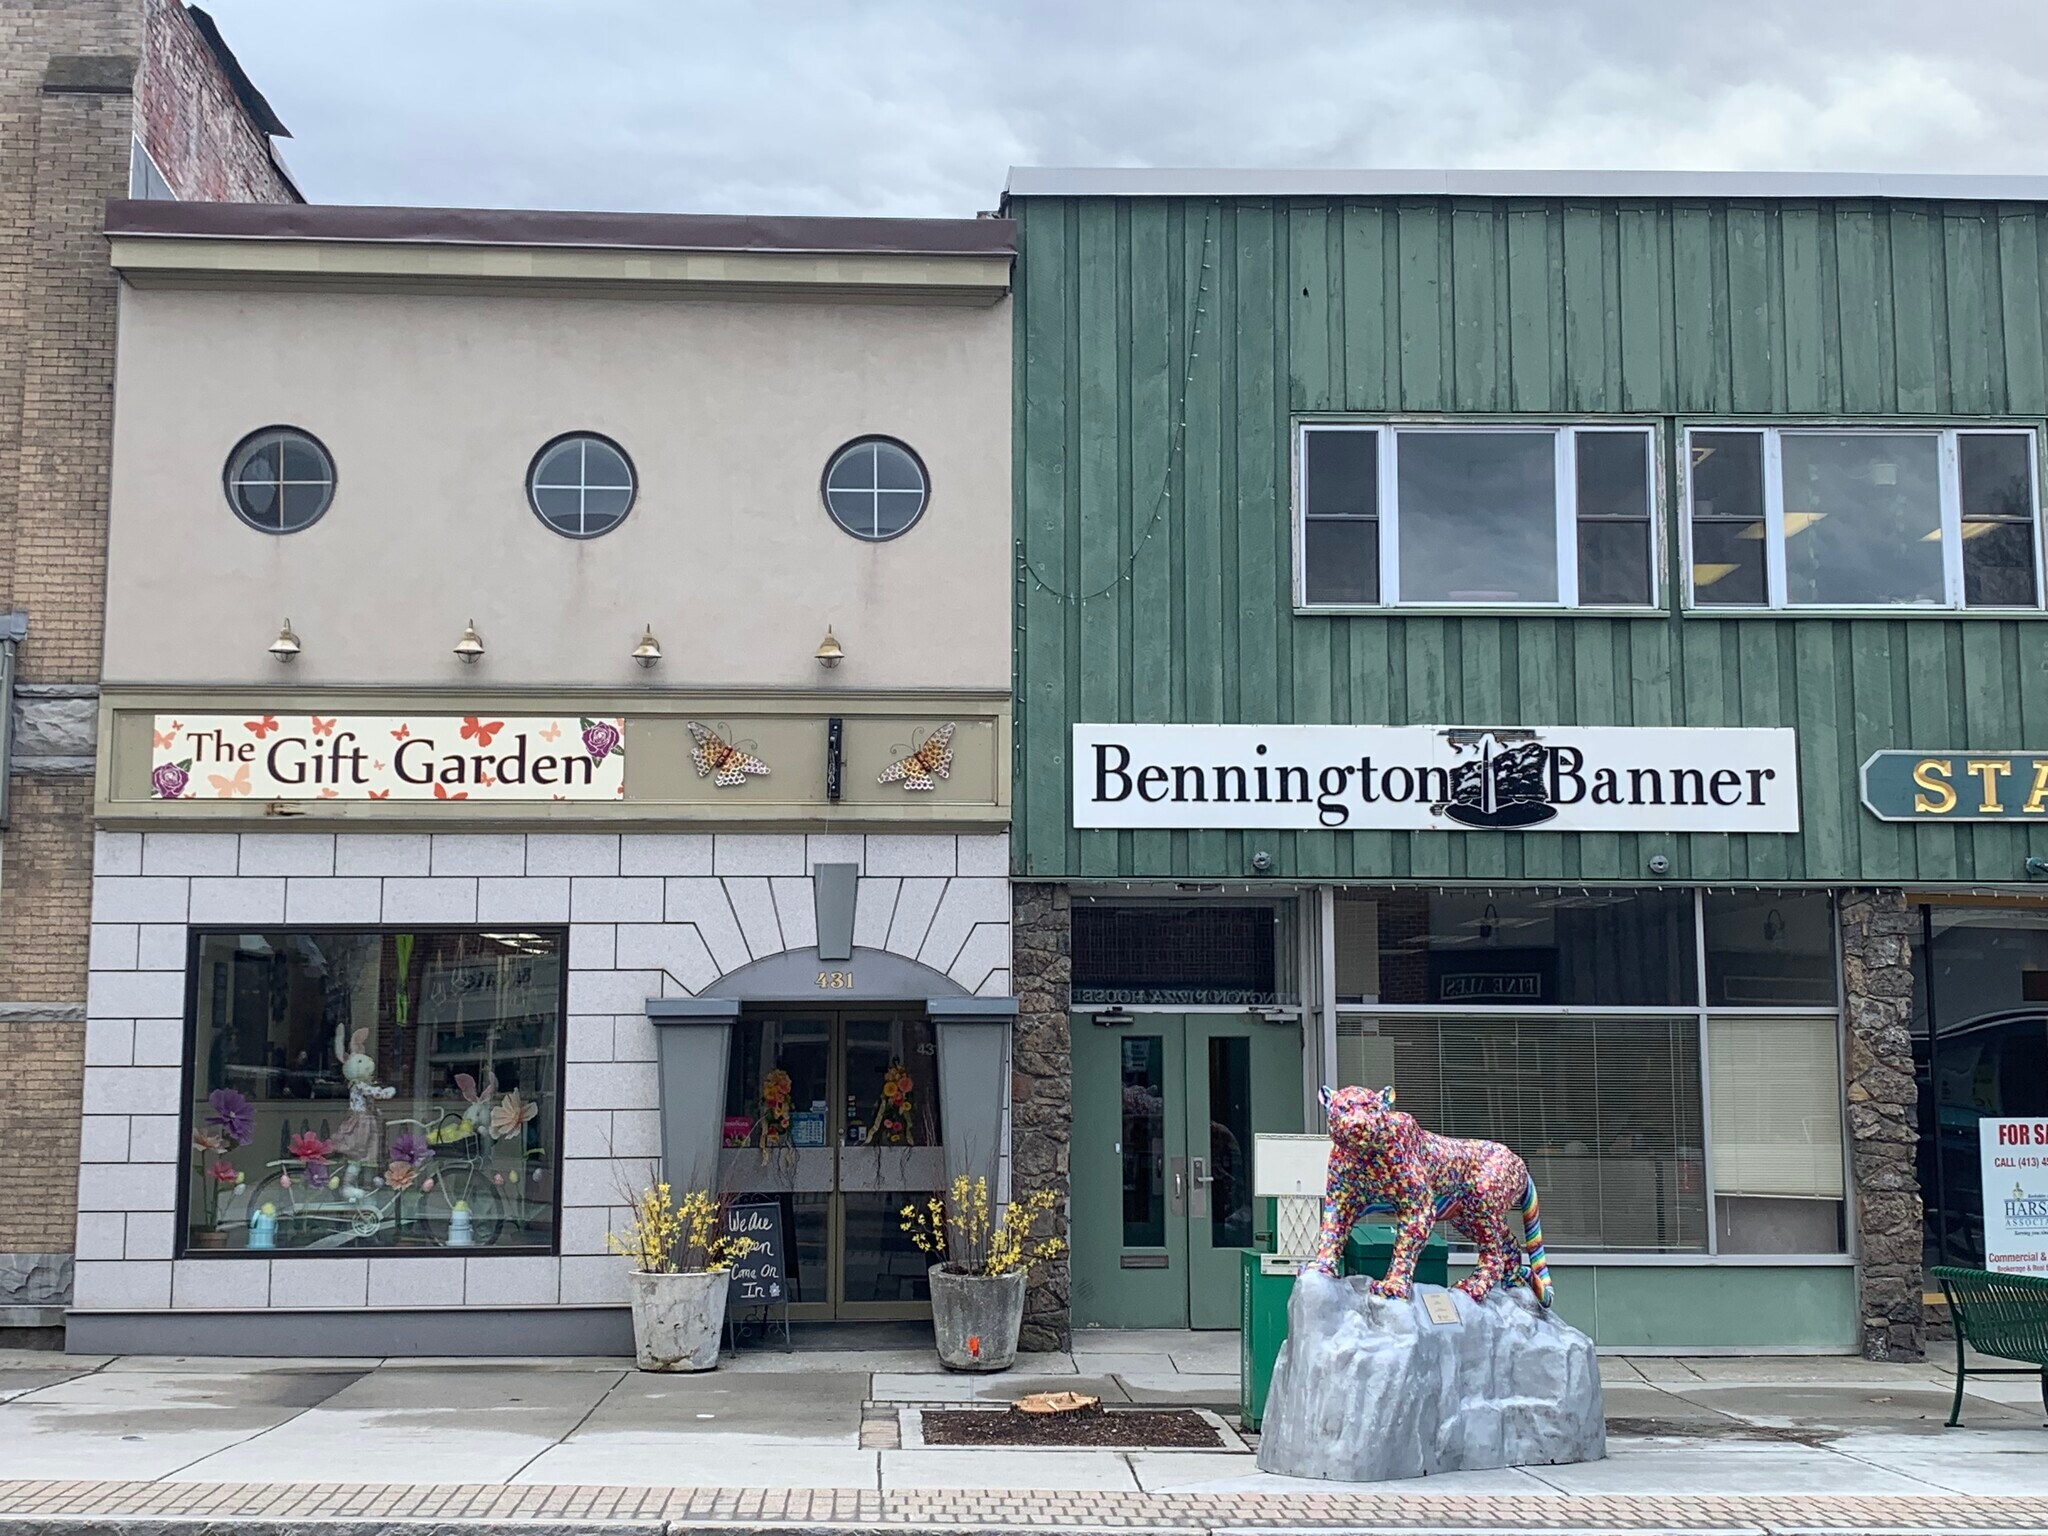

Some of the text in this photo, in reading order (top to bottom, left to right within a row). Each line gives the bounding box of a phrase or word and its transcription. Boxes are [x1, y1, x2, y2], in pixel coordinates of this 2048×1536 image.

[187, 729, 594, 785] The Gift Garden
[1091, 743, 1776, 827] Bennington Banner
[815, 971, 854, 989] 431
[917, 1043, 937, 1056] 43
[1999, 1124, 2048, 1145] FOR S
[1994, 1157, 2016, 1168] CALL
[2018, 1157, 2039, 1169] (413)
[2004, 1201, 2048, 1216] HARS
[728, 1211, 773, 1232] We Are
[1989, 1252, 2047, 1263] Commercial &
[731, 1263, 779, 1280] Come On
[741, 1282, 765, 1298] In
